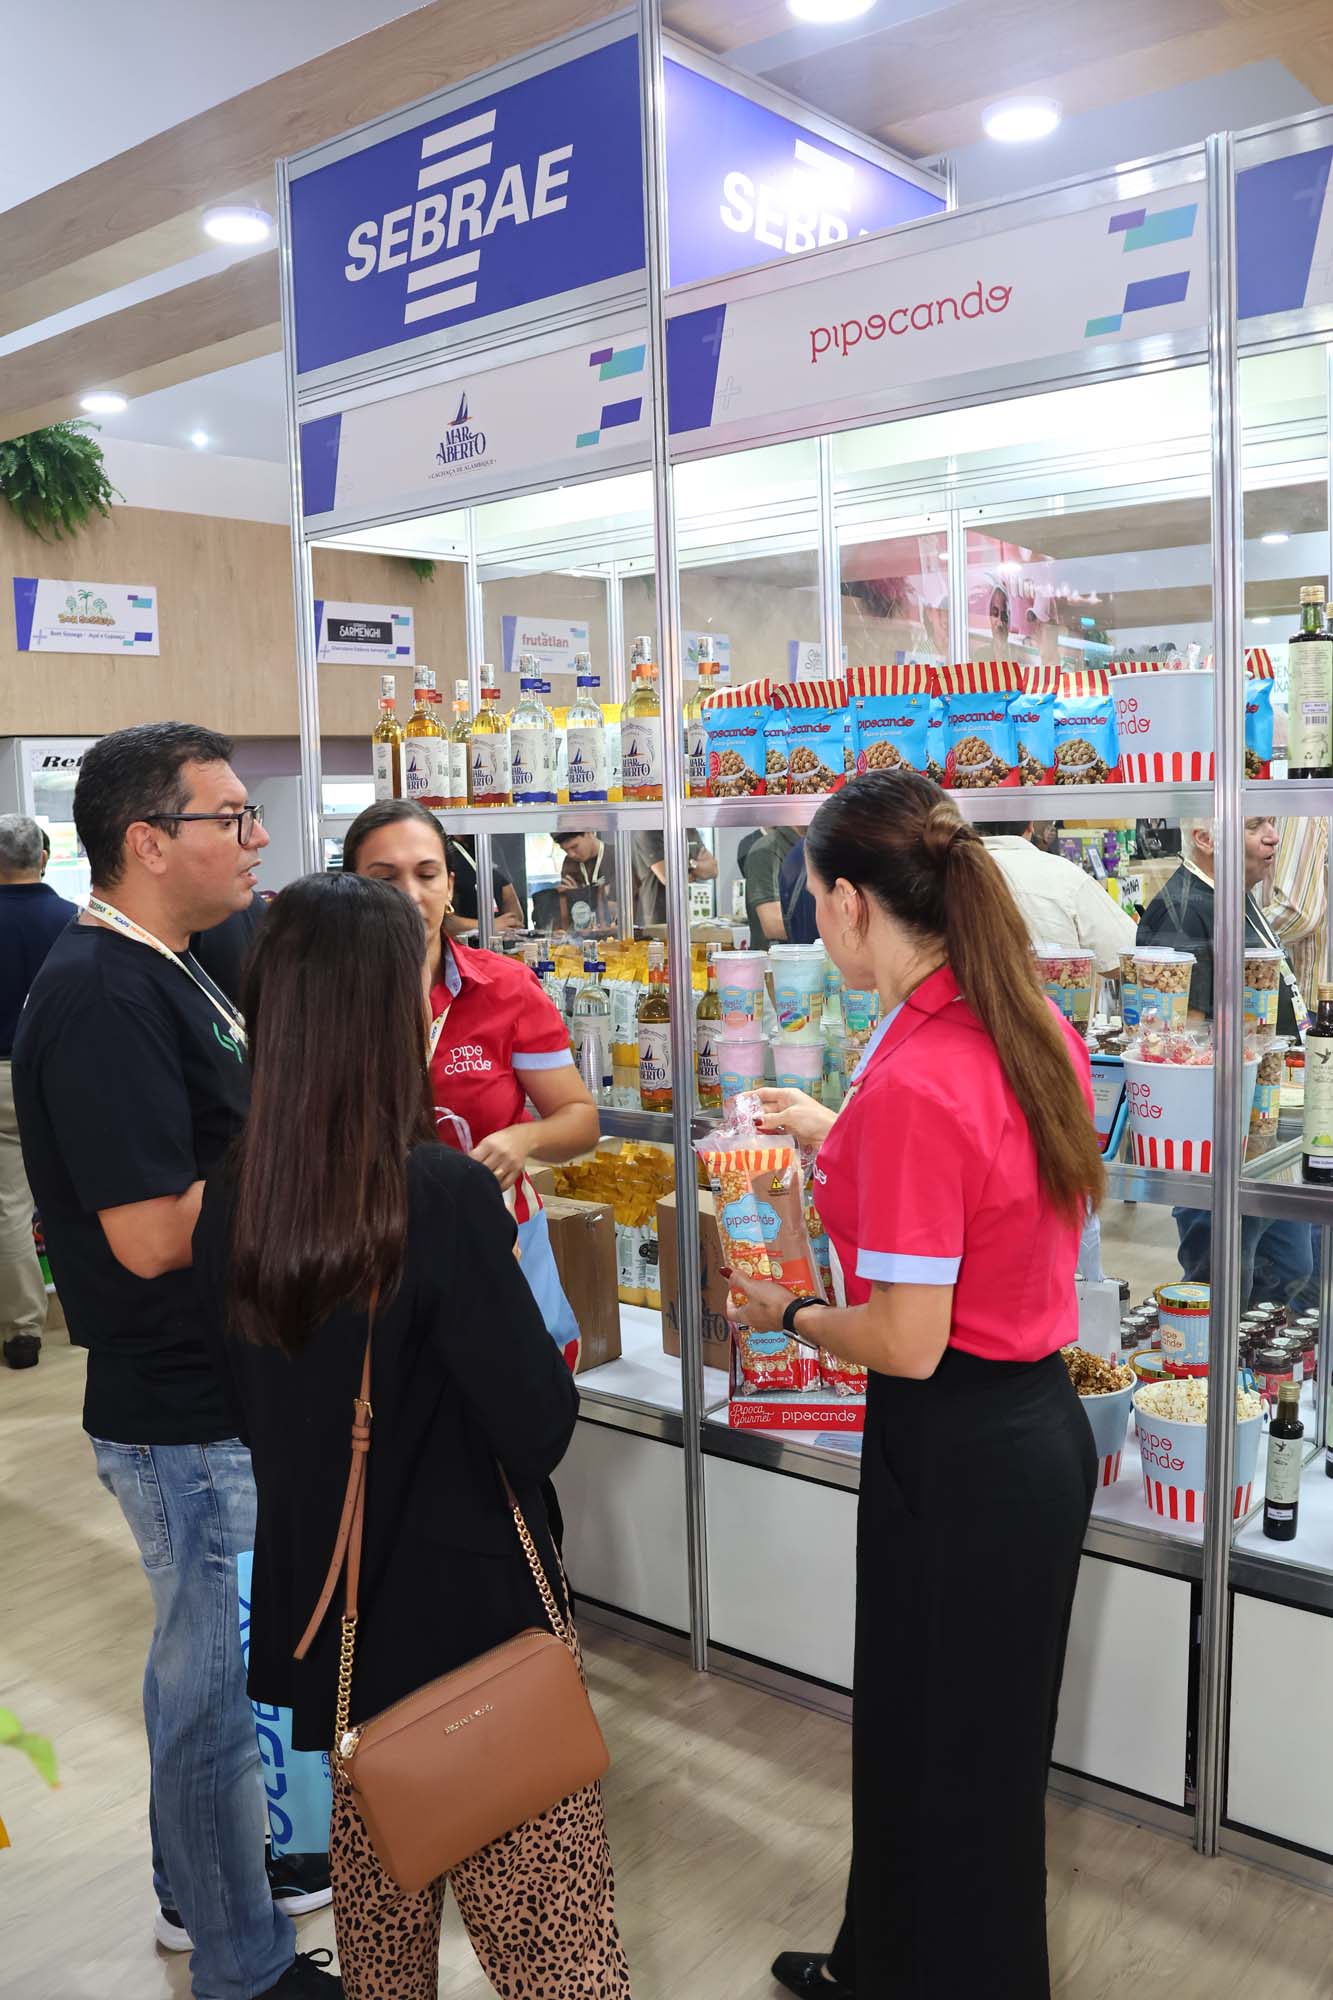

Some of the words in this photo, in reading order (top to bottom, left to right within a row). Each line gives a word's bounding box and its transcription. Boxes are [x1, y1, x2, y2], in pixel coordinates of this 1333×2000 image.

[344, 143, 574, 283] SEBRAE
[810, 280, 1013, 364] pipocando
[446, 425, 474, 446] MAR
[436, 431, 486, 465] ABERTO
[339, 625, 381, 639] SARMENGHI
[731, 1404, 764, 1416] Pipoca
[782, 1410, 856, 1424] pipocando
[732, 1412, 774, 1428] Gourmet
